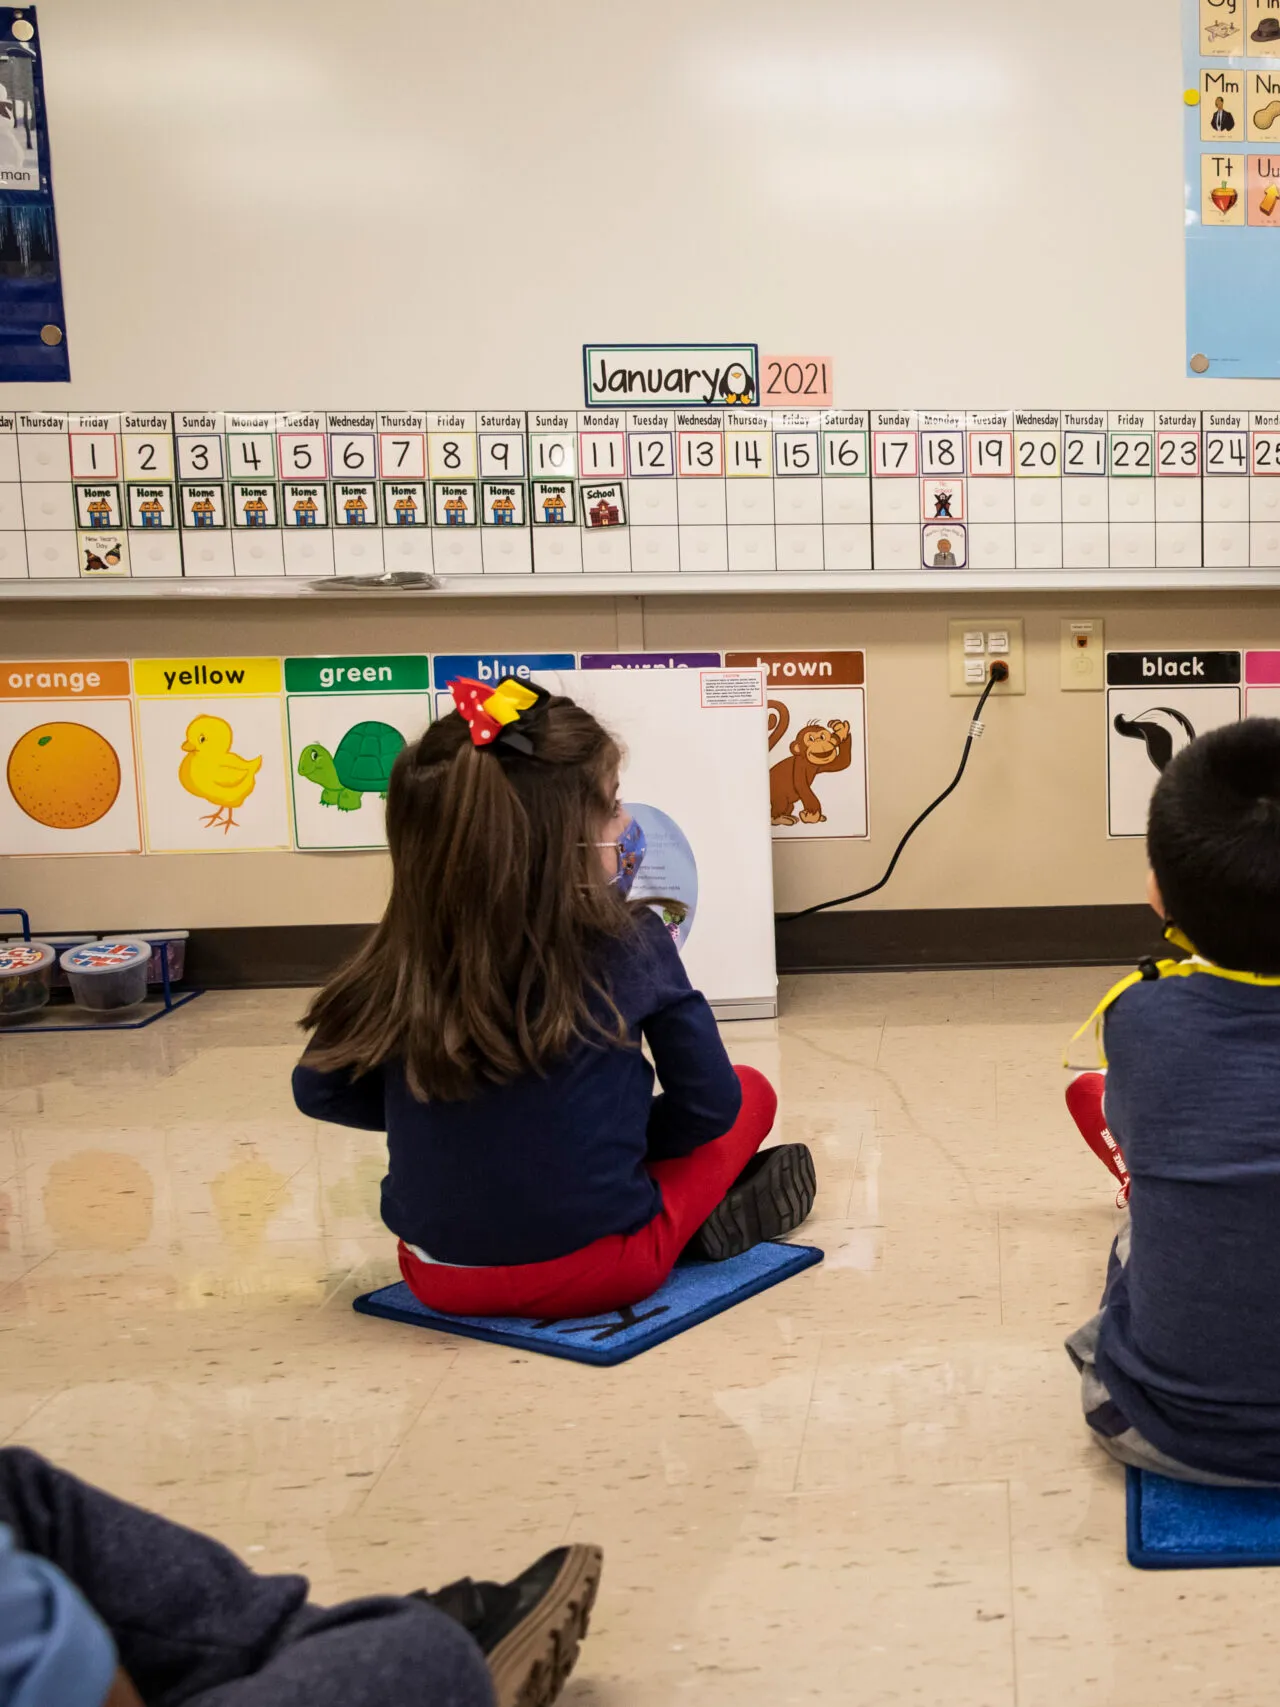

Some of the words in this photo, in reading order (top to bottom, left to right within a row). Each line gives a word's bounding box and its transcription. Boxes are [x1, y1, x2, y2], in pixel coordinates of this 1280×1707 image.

[1206, 73, 1238, 92] Mm
[1256, 75, 1280, 94] Nn
[1212, 158, 1233, 176] Tt
[1258, 158, 1279, 177] Uu
[593, 360, 720, 404] January
[767, 362, 827, 395] 2021
[20, 416, 63, 430] Thursday
[80, 416, 108, 430] Friday
[126, 416, 167, 430] Saturday
[183, 416, 216, 429] Sunday
[232, 416, 268, 429] Monday
[283, 416, 319, 429] Tuesday
[329, 416, 374, 429] Wednesday
[381, 416, 422, 429] Thursday
[438, 415, 464, 429] Friday
[481, 415, 520, 428] Saturday
[536, 415, 568, 428] Sunday
[584, 415, 619, 428] Monday
[633, 415, 668, 428] Tuesday
[677, 414, 721, 428] Wednesday
[728, 414, 767, 428] Thursday
[826, 414, 863, 428] Saturday
[879, 414, 909, 428] Sunday
[1016, 414, 1058, 427] Wednesday
[1065, 414, 1103, 427] Thursday
[1118, 415, 1144, 427] Friday
[1159, 414, 1196, 428] Saturday
[1210, 415, 1240, 428] Sunday
[138, 444, 156, 470] 2
[191, 445, 208, 470] 3
[243, 442, 261, 470] 4
[294, 444, 311, 469] 5
[344, 442, 364, 469] 6
[392, 441, 410, 467] 7
[443, 442, 461, 468] 8
[491, 443, 508, 470] 9
[540, 443, 563, 468] 10
[593, 442, 614, 467] 11
[639, 441, 665, 467] 12
[688, 441, 713, 466] 13
[736, 441, 761, 468] 14
[784, 442, 809, 468] 15
[830, 440, 858, 466] 16
[883, 442, 908, 467] 17
[929, 439, 954, 465] 18
[979, 440, 1002, 466] 19
[1020, 442, 1056, 466] 20
[1068, 440, 1100, 465] 21
[1114, 442, 1149, 466] 22
[1160, 440, 1196, 465] 23
[1209, 439, 1246, 466] 24
[84, 489, 111, 497] Home
[137, 488, 163, 497] Home
[189, 488, 214, 498] Home
[241, 488, 267, 496] Home
[291, 487, 317, 496] Home
[342, 486, 366, 495] Home
[392, 486, 416, 495] Home
[442, 487, 467, 495] Home
[490, 486, 515, 495] Home
[541, 485, 565, 493] Home
[587, 489, 615, 499] School
[478, 660, 529, 679] blue
[1142, 657, 1204, 676] black
[9, 671, 100, 692] orange
[164, 666, 244, 690] yellow
[320, 666, 392, 687] green
